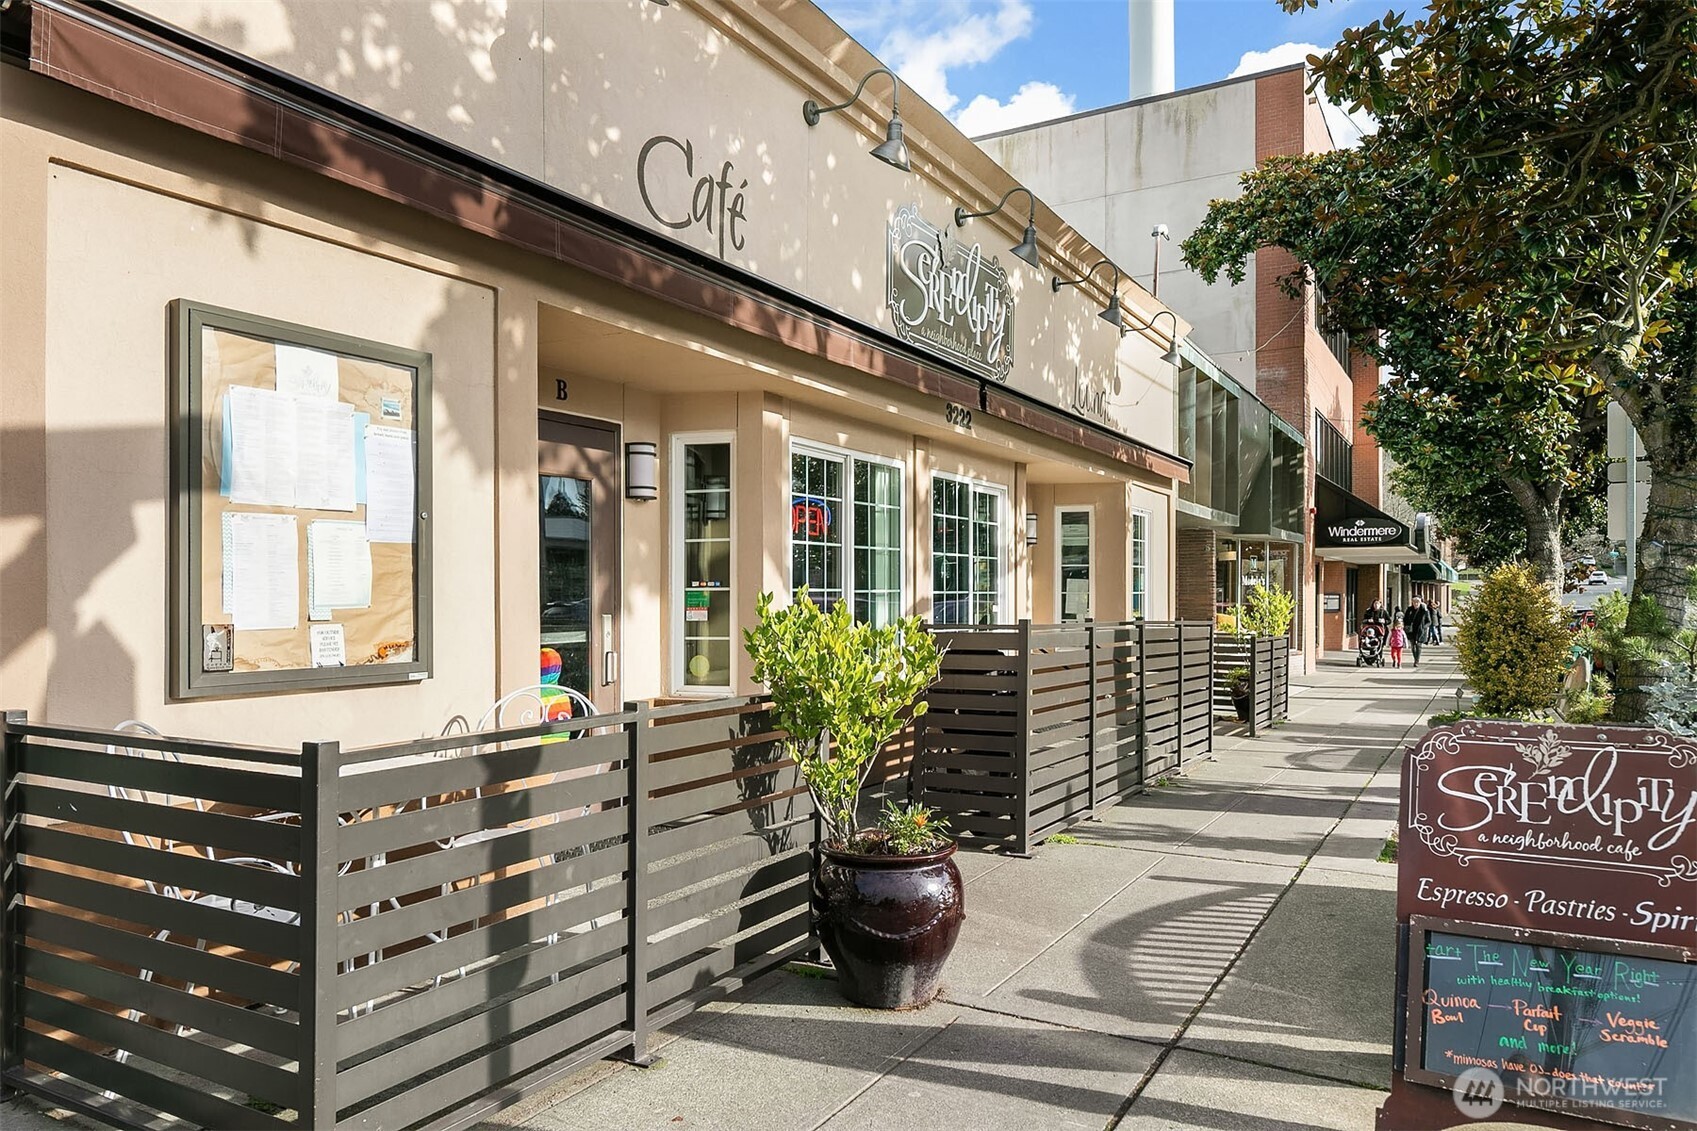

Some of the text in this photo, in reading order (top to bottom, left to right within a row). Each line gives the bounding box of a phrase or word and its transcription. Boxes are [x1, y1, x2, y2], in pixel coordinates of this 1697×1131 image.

[637, 135, 748, 260] Café
[927, 325, 967, 355] neighborhood
[966, 341, 983, 365] place
[556, 379, 568, 400] B
[946, 402, 972, 430] 3222
[1328, 526, 1397, 537] Windermere
[1477, 829, 1643, 861] a neighborhood cafe
[1417, 878, 1697, 933] Espresso Pastries Spir
[1466, 944, 1500, 972] The
[1512, 948, 1550, 977] New
[1560, 954, 1602, 984] Year
[1457, 975, 1485, 985] with
[1490, 976, 1532, 992] healthy
[1538, 983, 1595, 998] breakfast
[1422, 988, 1660, 1035] Quinoa Parfait Veggie
[1431, 1009, 1668, 1048] Bowl Cup Scramble
[1498, 1036, 1528, 1050] and
[1501, 1058, 1526, 1073] have
[1579, 1071, 1605, 1085] that
